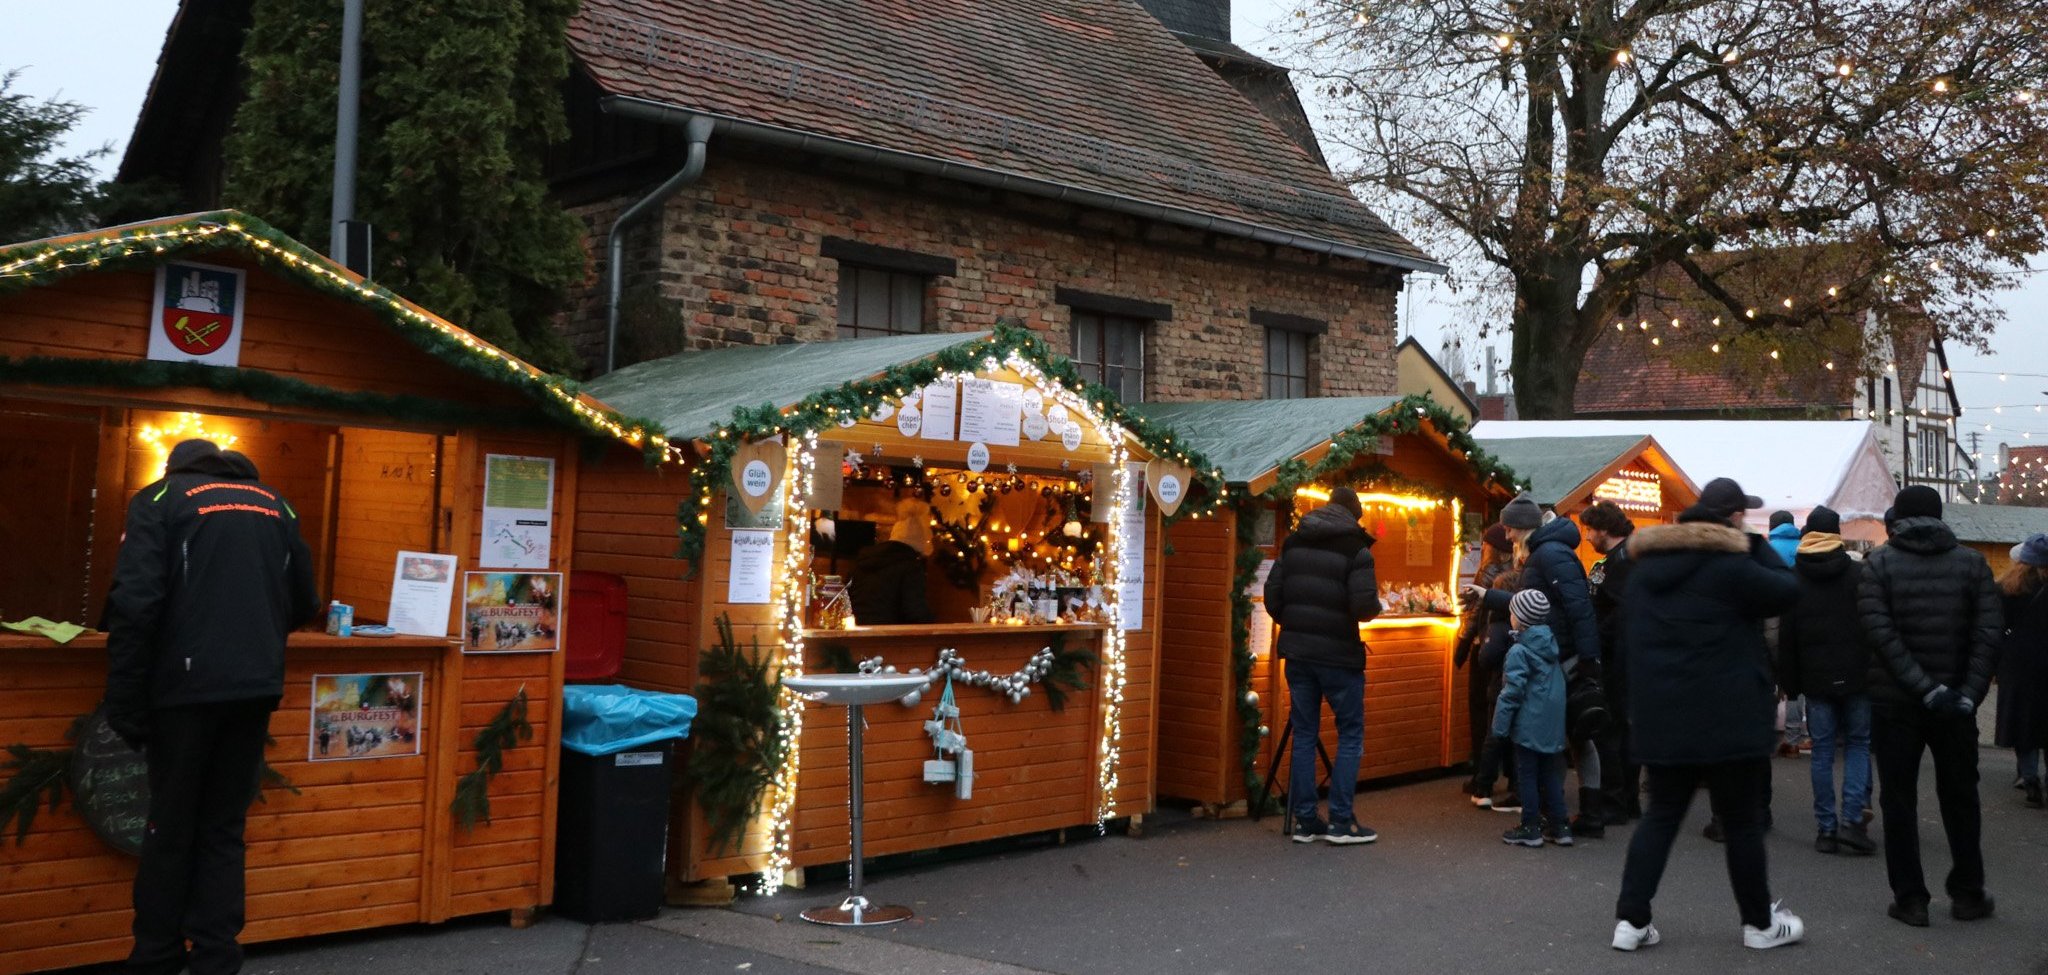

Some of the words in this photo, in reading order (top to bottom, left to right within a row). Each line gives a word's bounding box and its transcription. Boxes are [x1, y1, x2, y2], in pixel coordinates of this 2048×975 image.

[901, 422, 917, 430] chen
[971, 449, 986, 458] Glüh
[748, 468, 766, 479] Glüh
[747, 479, 766, 488] wein
[1162, 480, 1177, 489] Glüh
[1161, 489, 1177, 497] wein
[489, 607, 540, 617] BURGFEST
[340, 710, 397, 721] BURGFEST
